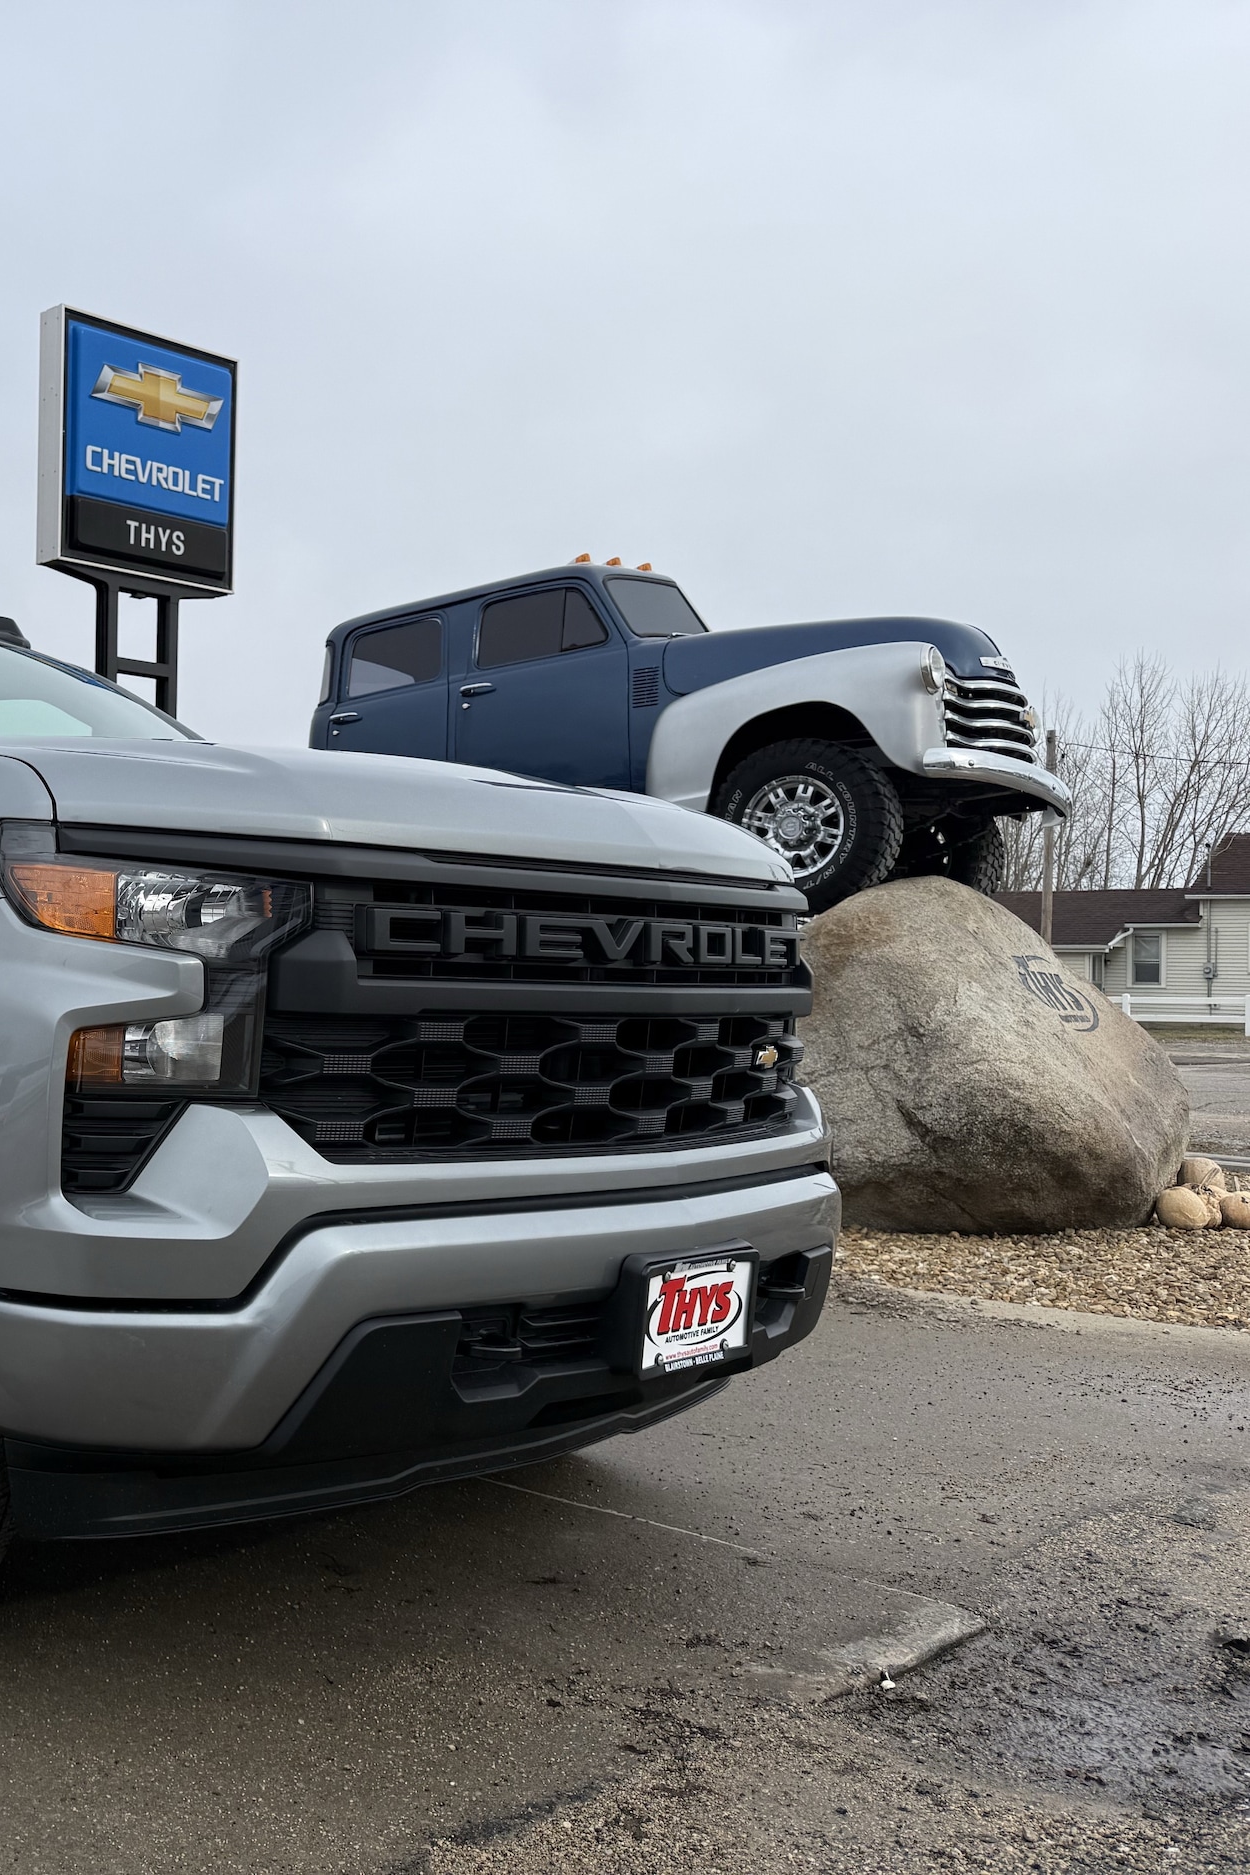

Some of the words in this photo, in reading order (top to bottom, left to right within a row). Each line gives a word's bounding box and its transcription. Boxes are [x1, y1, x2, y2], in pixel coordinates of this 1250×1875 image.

[85, 445, 225, 502] CHEVROLET
[126, 520, 186, 556] THYS
[805, 761, 834, 781] ALL
[836, 781, 857, 864] COUNTRY
[360, 904, 806, 968] CHEVROLET
[657, 1274, 734, 1336] THYS
[665, 1329, 699, 1343] AUTOMOTIVE
[701, 1325, 719, 1336] FAMILY
